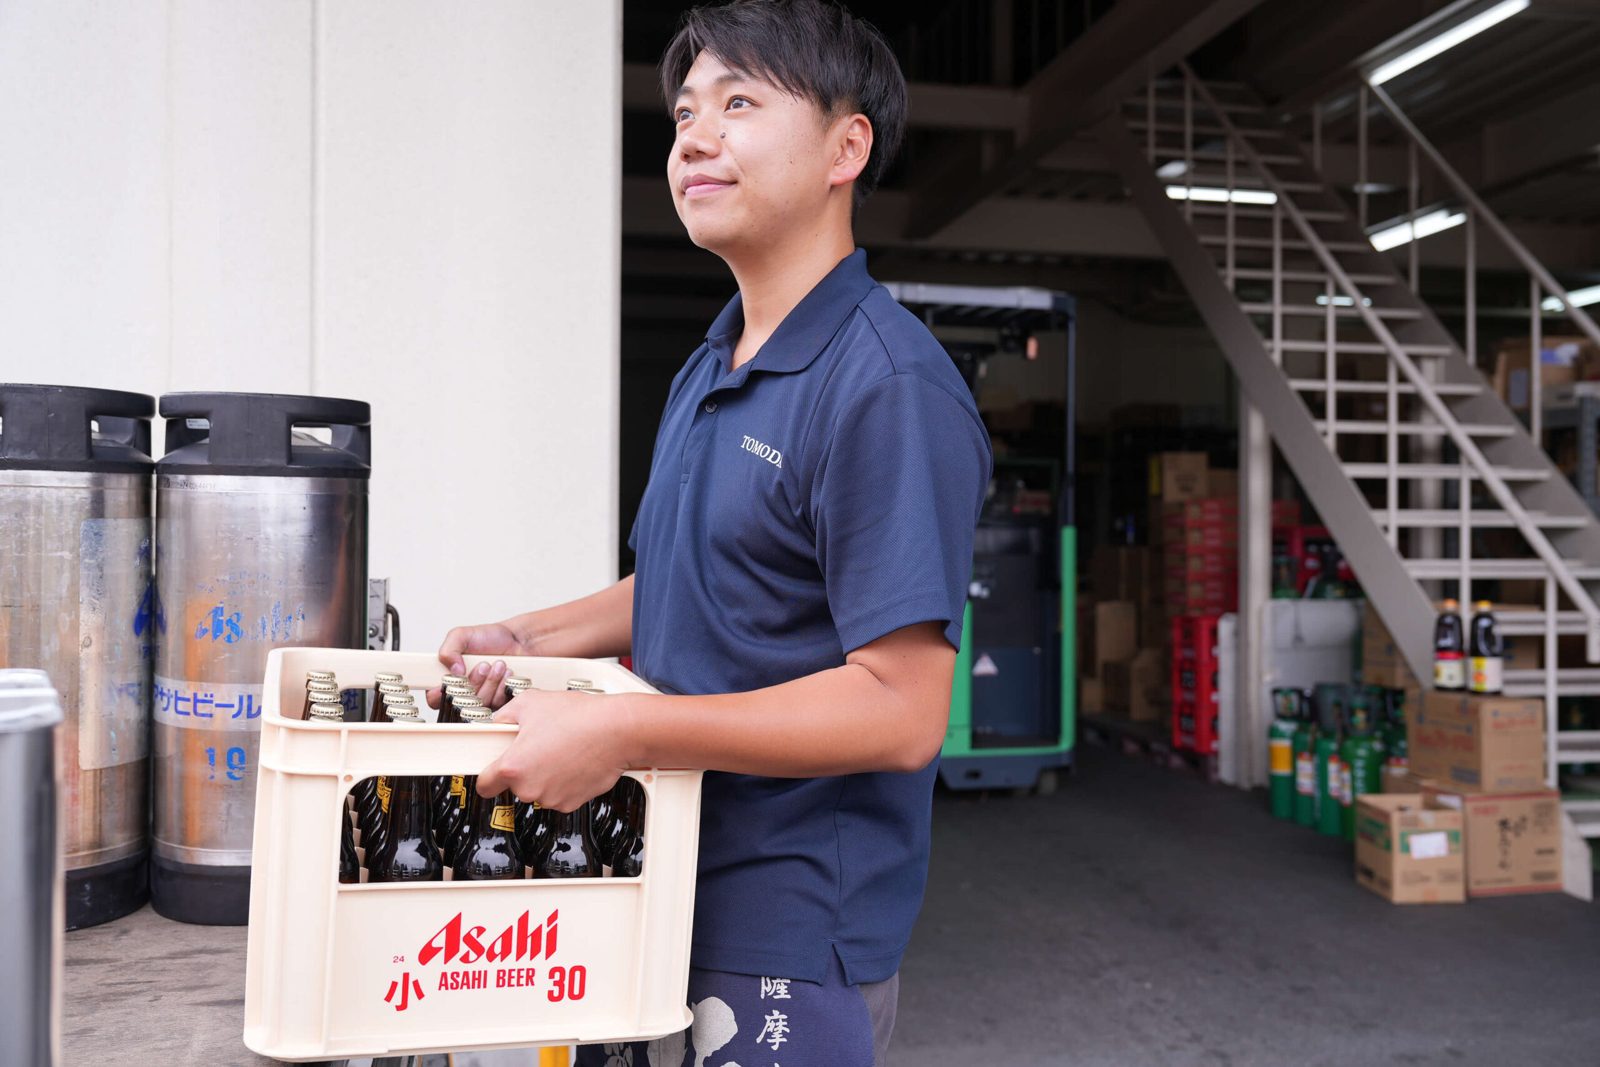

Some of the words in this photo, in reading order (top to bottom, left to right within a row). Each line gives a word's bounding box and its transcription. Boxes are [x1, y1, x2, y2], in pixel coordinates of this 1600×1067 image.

[206, 746, 247, 781] 19
[418, 908, 559, 966] Asahi
[392, 954, 406, 964] 24
[383, 972, 425, 1012] 小
[437, 969, 489, 991] ASAHI
[495, 967, 536, 989] BEER
[547, 965, 587, 1003] 30
[756, 976, 792, 1067] 薩摩
